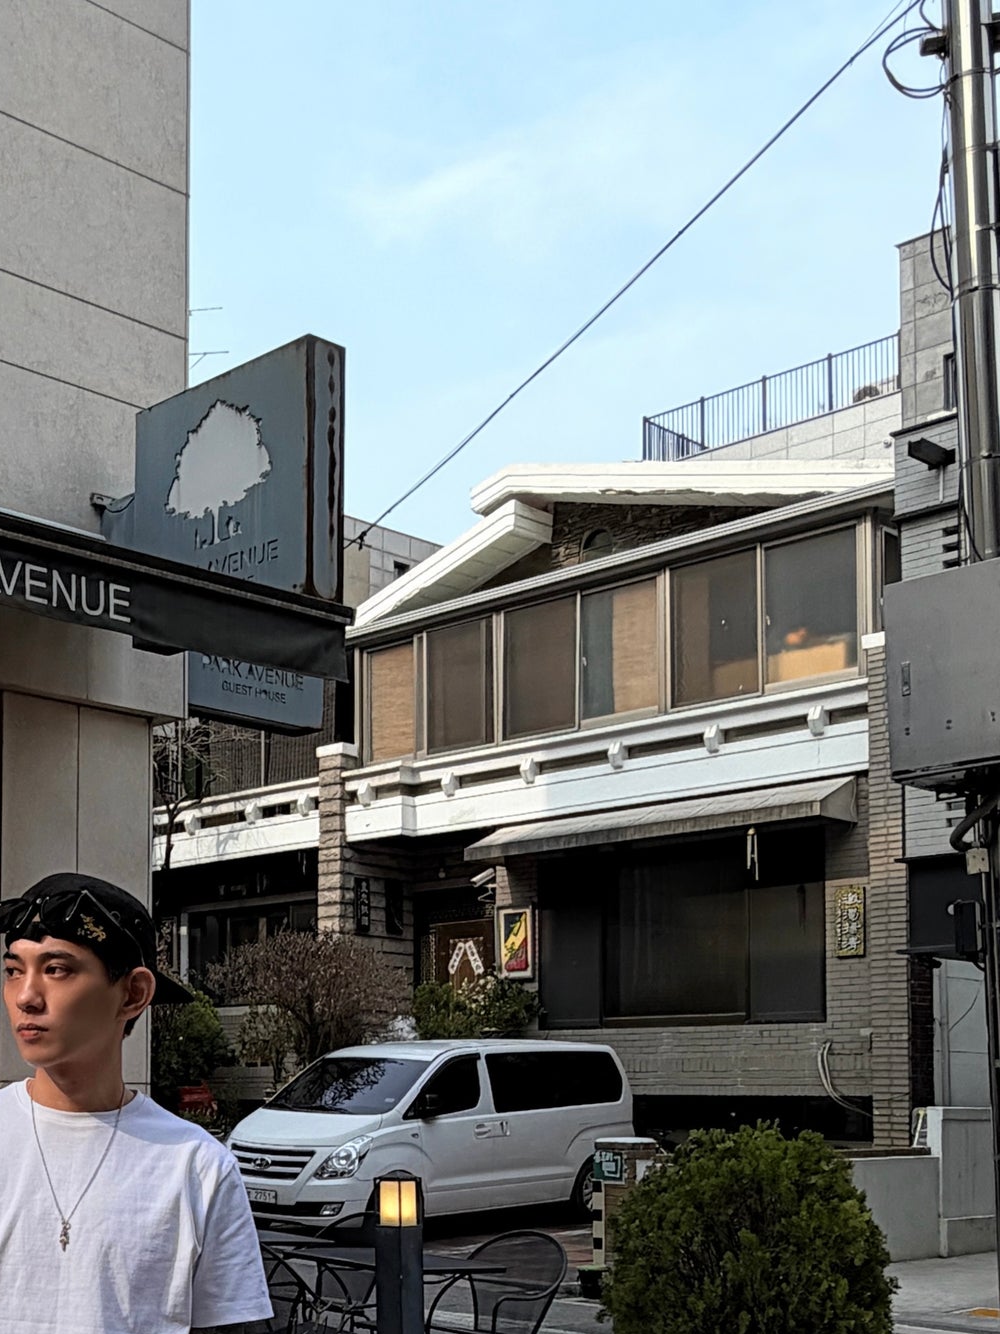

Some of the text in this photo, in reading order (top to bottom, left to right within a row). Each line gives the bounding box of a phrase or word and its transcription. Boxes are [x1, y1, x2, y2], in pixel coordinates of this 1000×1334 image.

[208, 539, 279, 574] AVENUE
[201, 654, 304, 691] PARK AVENUE
[221, 681, 286, 704] GUEST HOUSE
